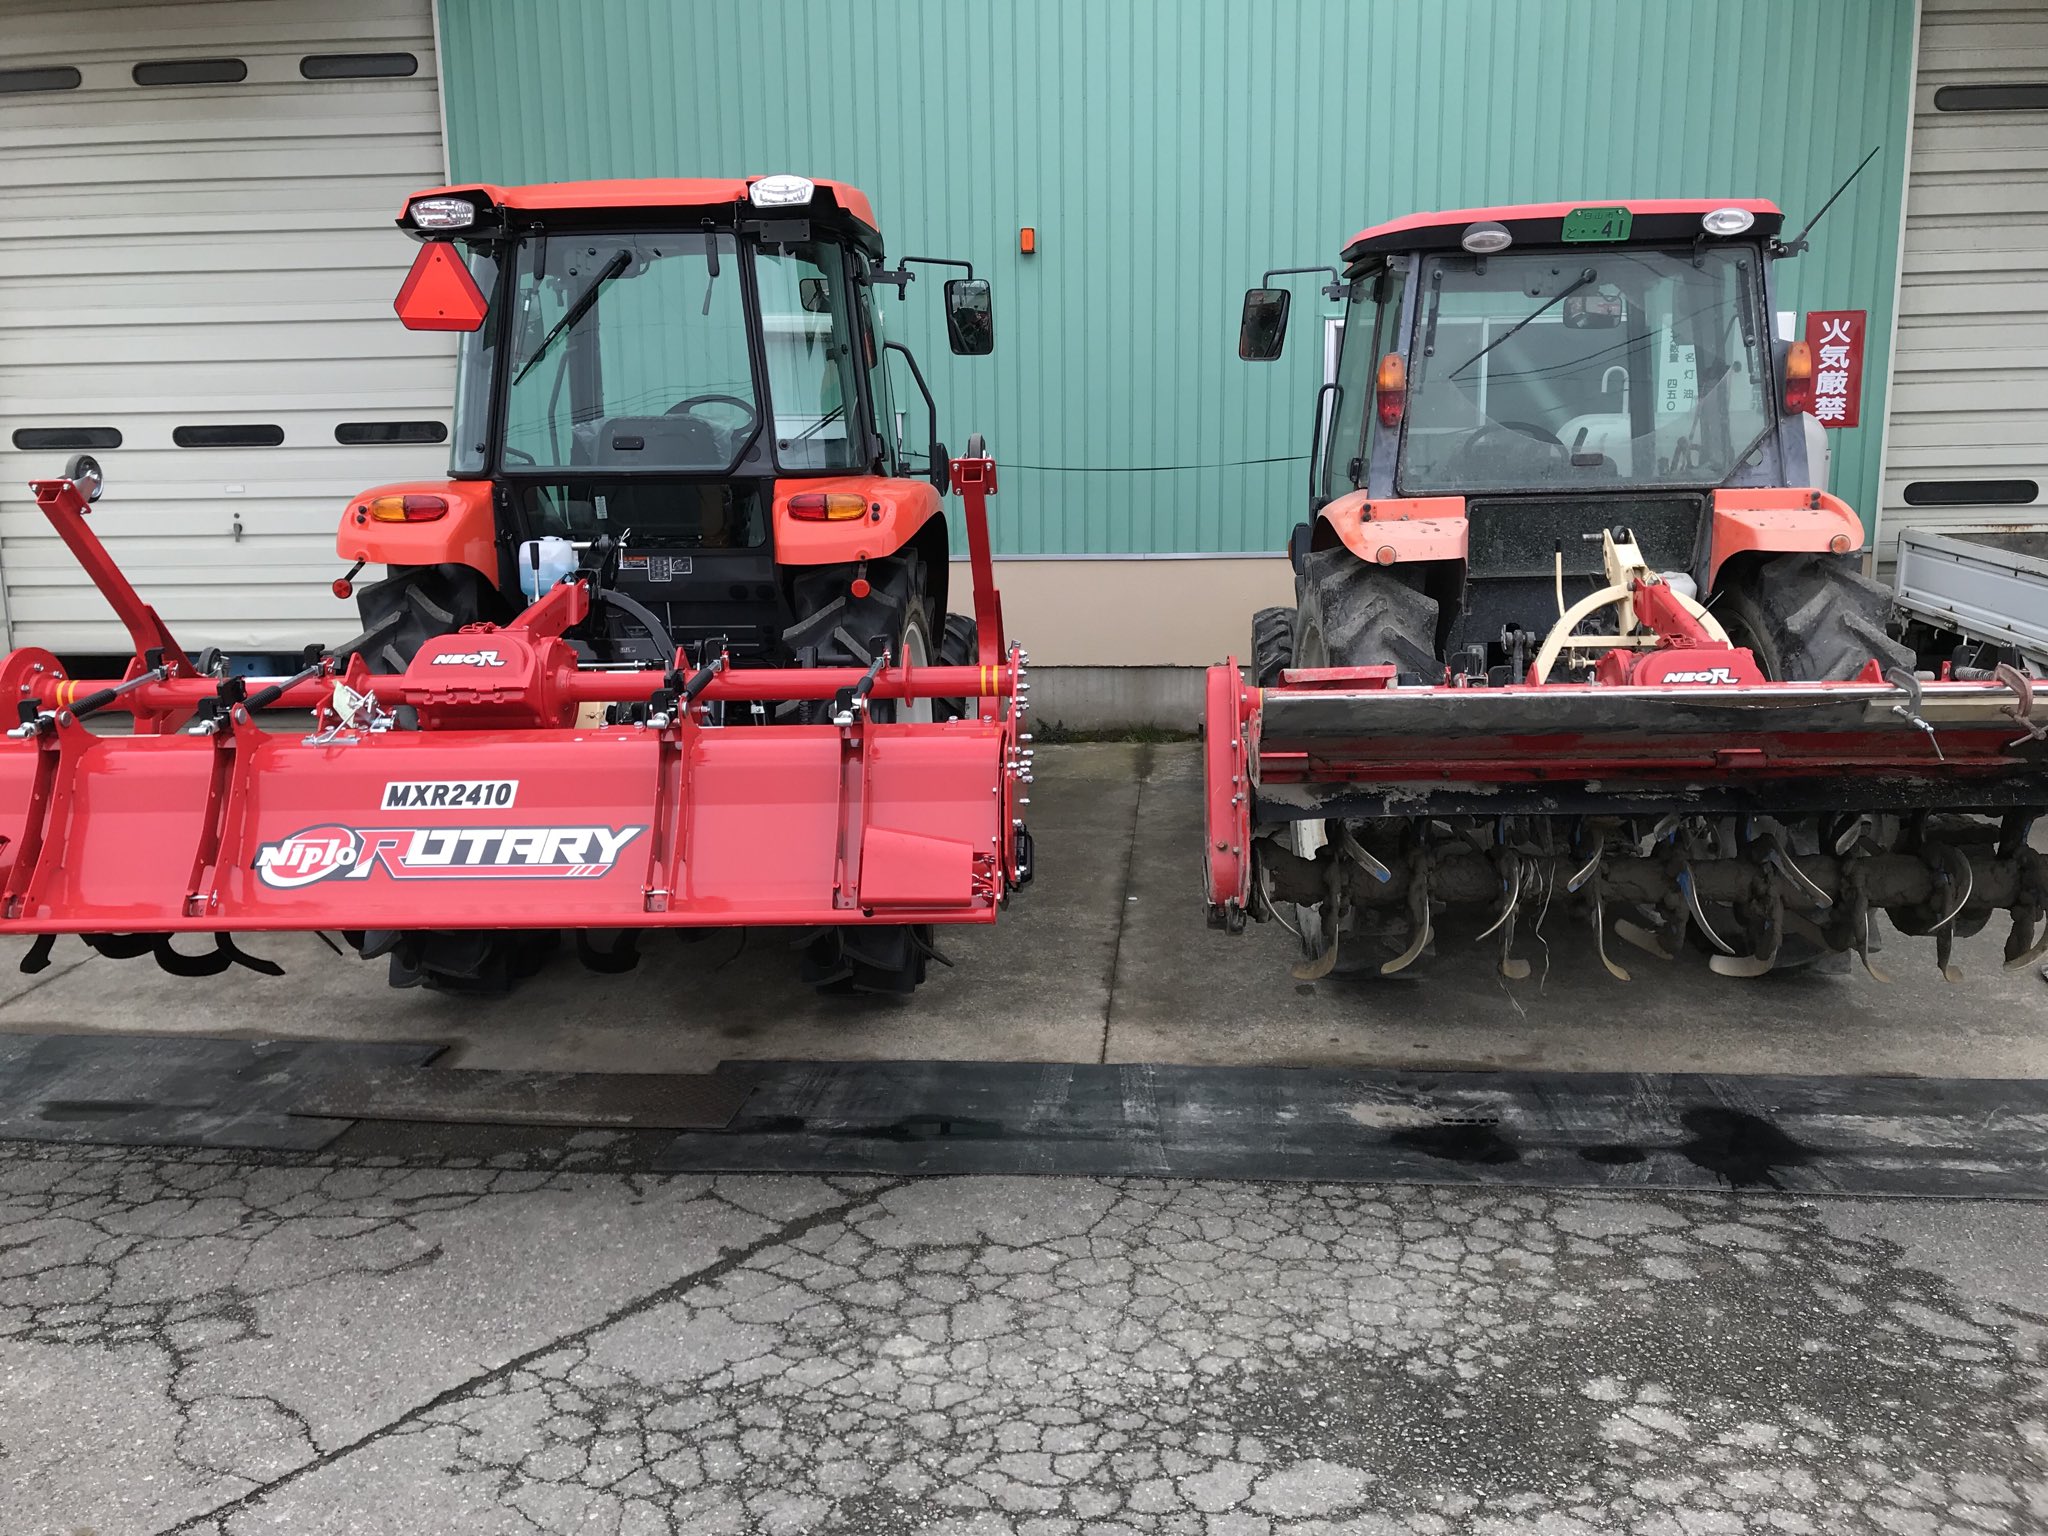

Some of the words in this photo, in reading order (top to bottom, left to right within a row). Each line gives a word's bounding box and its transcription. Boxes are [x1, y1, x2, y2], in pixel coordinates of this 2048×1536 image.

[1815, 318, 1851, 421] 火気厳禁
[386, 782, 512, 807] MXR2410
[256, 837, 358, 874] Niplo
[345, 828, 643, 878] ROTARY
